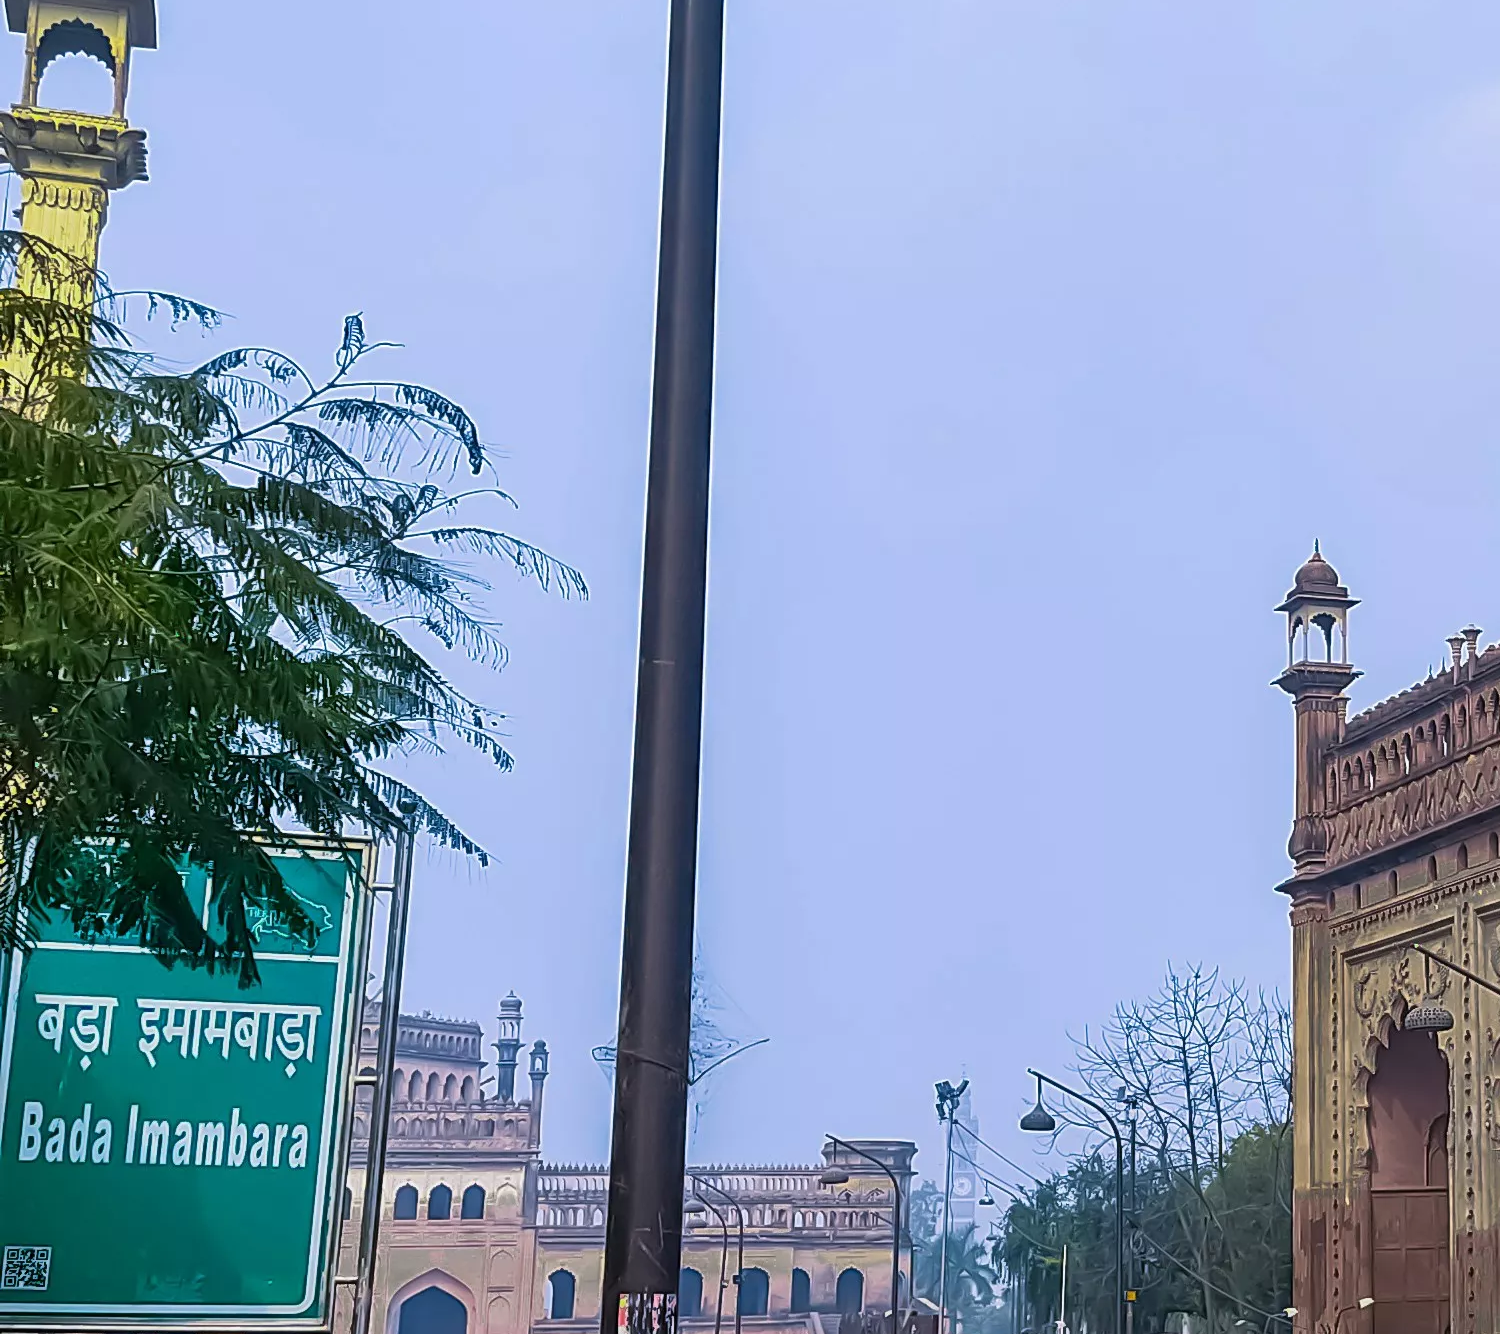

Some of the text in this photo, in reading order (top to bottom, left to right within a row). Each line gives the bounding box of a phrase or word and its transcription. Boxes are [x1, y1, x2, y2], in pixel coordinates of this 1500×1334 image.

[35, 993, 323, 1079] बड़ा इमामबाड़ा
[18, 1101, 309, 1168] Bada Imambara
